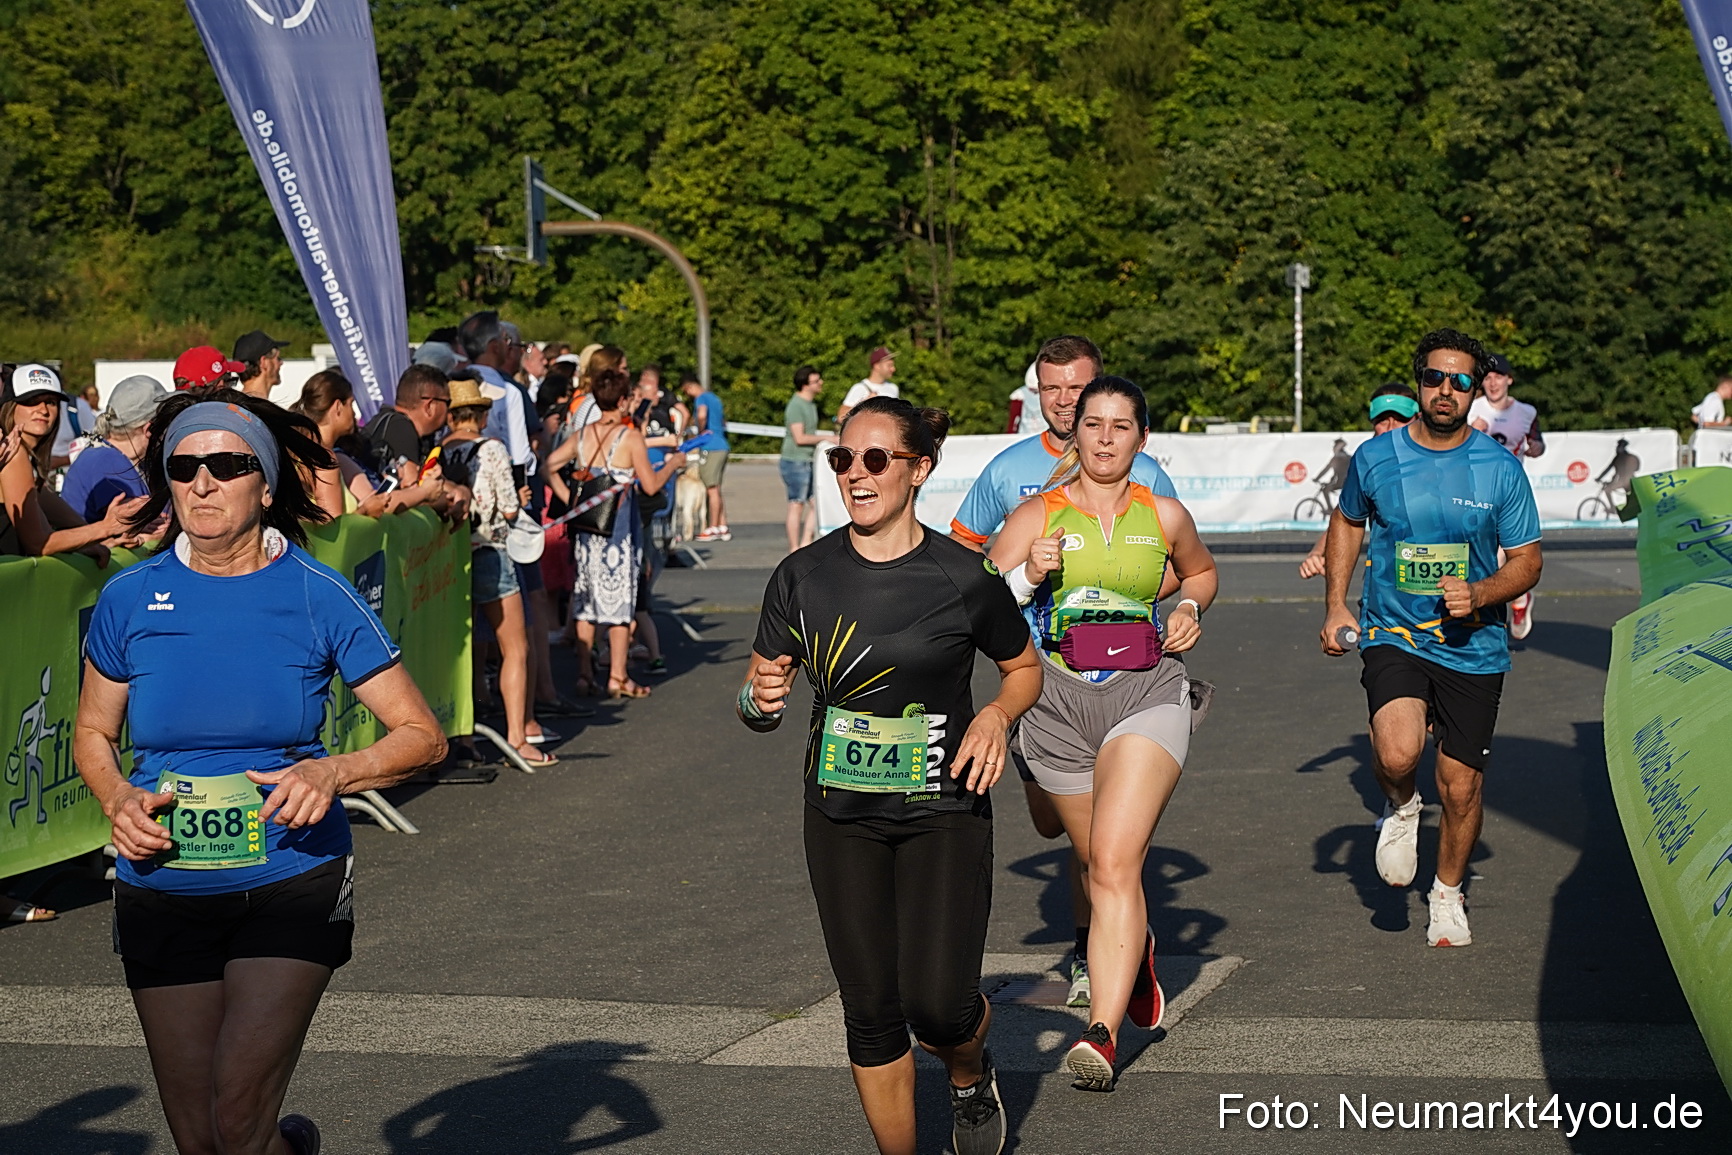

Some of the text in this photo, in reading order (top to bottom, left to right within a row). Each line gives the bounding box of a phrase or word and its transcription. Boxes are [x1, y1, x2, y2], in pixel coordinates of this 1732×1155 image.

[1452, 497, 1494, 511] TR PLAST
[1408, 561, 1457, 579] 1932
[1458, 563, 1466, 581] 022
[147, 602, 175, 611] erima
[848, 727, 881, 737] Firmenlauf
[825, 743, 837, 772] RUN
[845, 740, 901, 768] 674
[834, 764, 911, 779] Neubauer Anna
[911, 747, 922, 782] 2022
[165, 807, 244, 839] 1368
[246, 809, 260, 853] 2022
[209, 841, 236, 854] Inge
